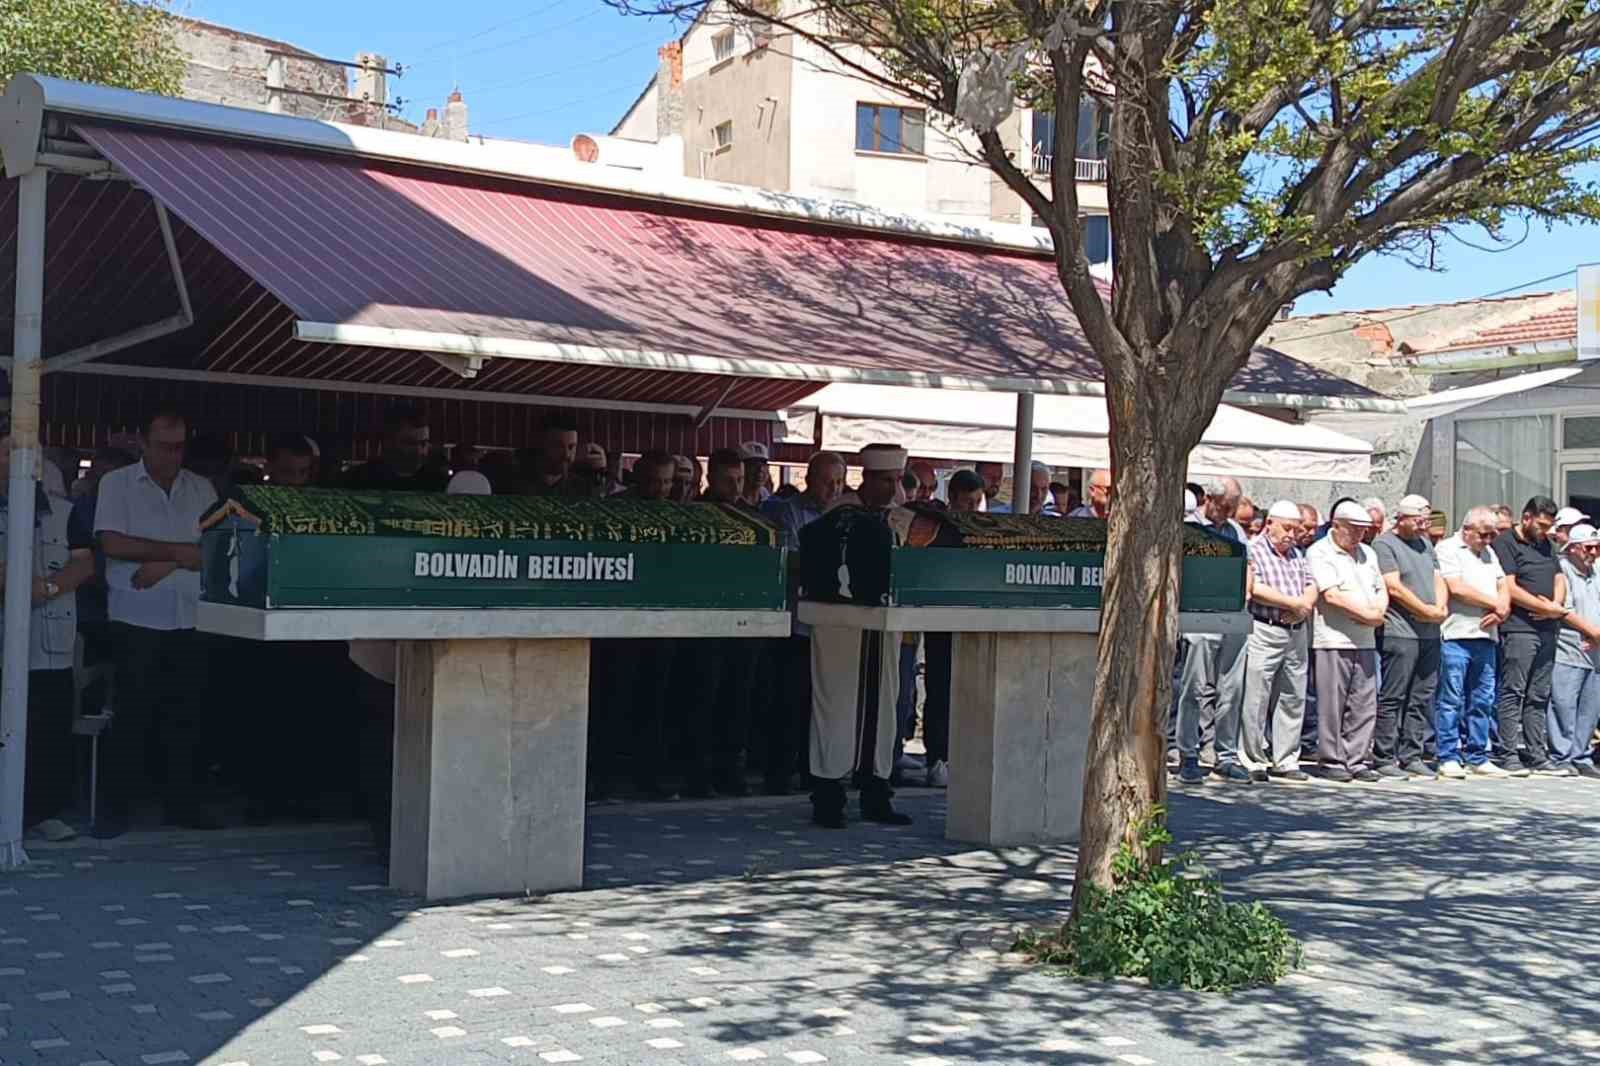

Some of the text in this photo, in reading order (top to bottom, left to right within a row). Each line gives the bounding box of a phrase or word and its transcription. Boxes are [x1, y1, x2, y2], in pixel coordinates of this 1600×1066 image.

[415, 550, 634, 581] BOLVADİN BELEDİYESİ
[1005, 561, 1075, 586] BOLVADİN
